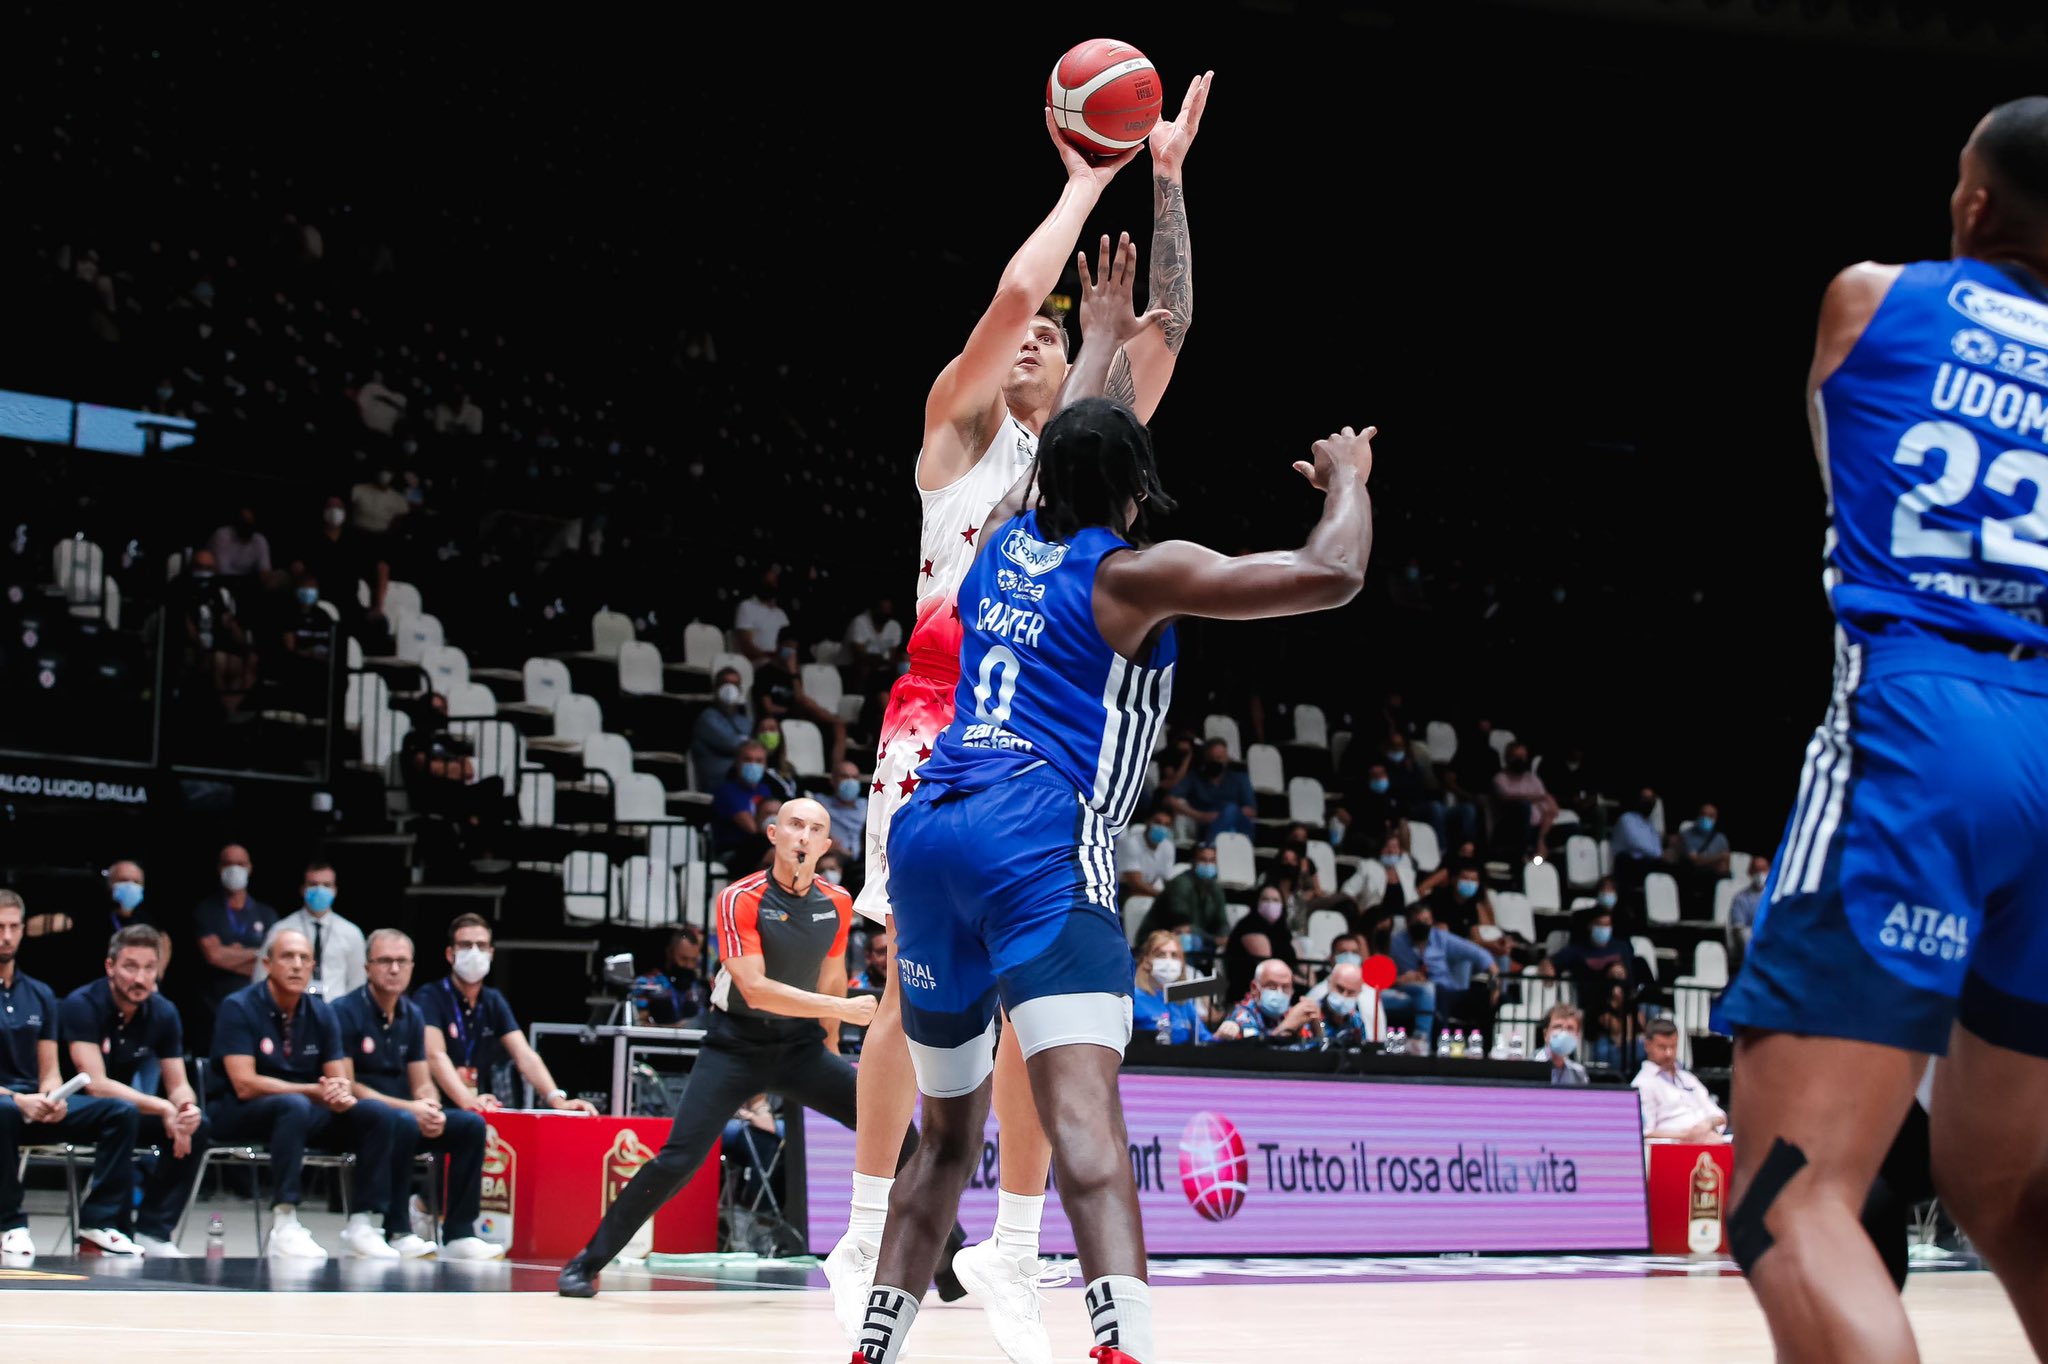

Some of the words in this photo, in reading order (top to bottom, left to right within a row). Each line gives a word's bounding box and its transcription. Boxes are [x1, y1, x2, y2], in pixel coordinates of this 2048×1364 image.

[1891, 420, 2048, 572] 22
[973, 645, 1020, 727] 0
[43, 777, 94, 799] LUCIO
[95, 782, 147, 803] DALLA
[481, 1176, 508, 1198] BA
[1129, 1135, 1165, 1192] ort
[1257, 1143, 1346, 1192] Tutto
[1351, 1141, 1371, 1192] il
[1376, 1155, 1441, 1192] rosa
[1447, 1143, 1519, 1193] della
[1525, 1146, 1577, 1192] vita
[1085, 1281, 1119, 1350] LITE
